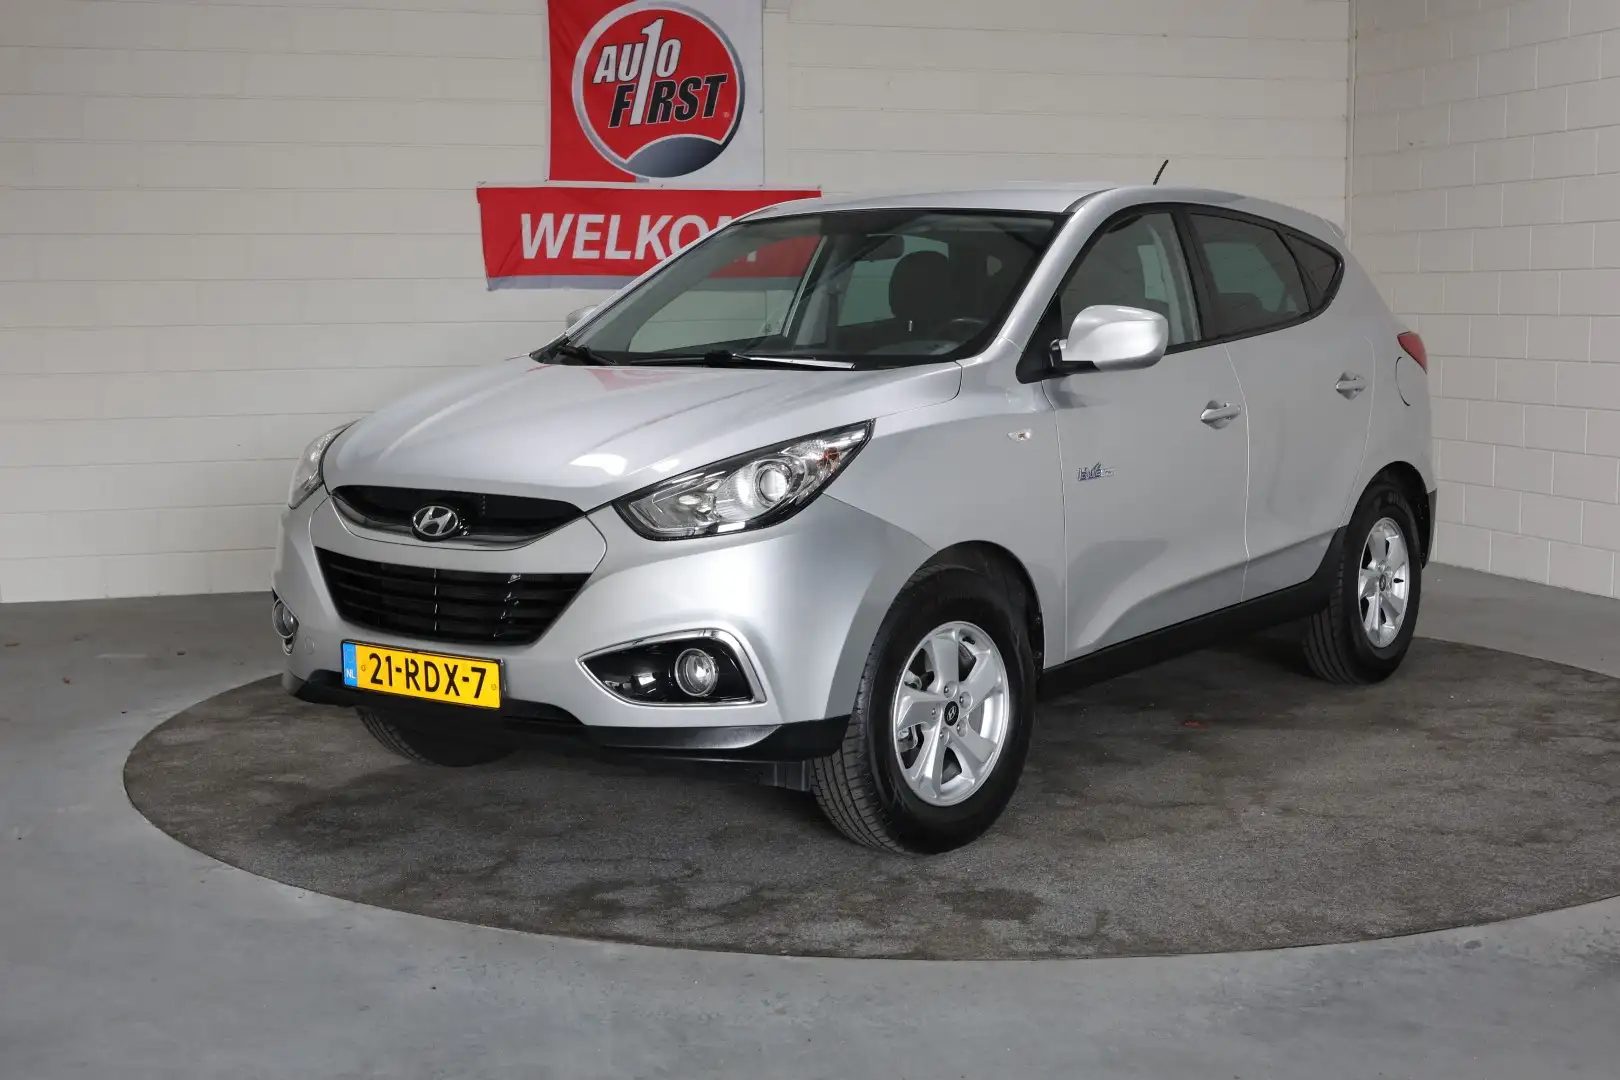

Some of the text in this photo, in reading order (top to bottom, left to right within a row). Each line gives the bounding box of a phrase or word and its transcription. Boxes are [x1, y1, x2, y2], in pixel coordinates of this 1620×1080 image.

[520, 212, 733, 261] WELKO
[346, 668, 357, 679] NL
[369, 652, 487, 699] 21-RDX-7
